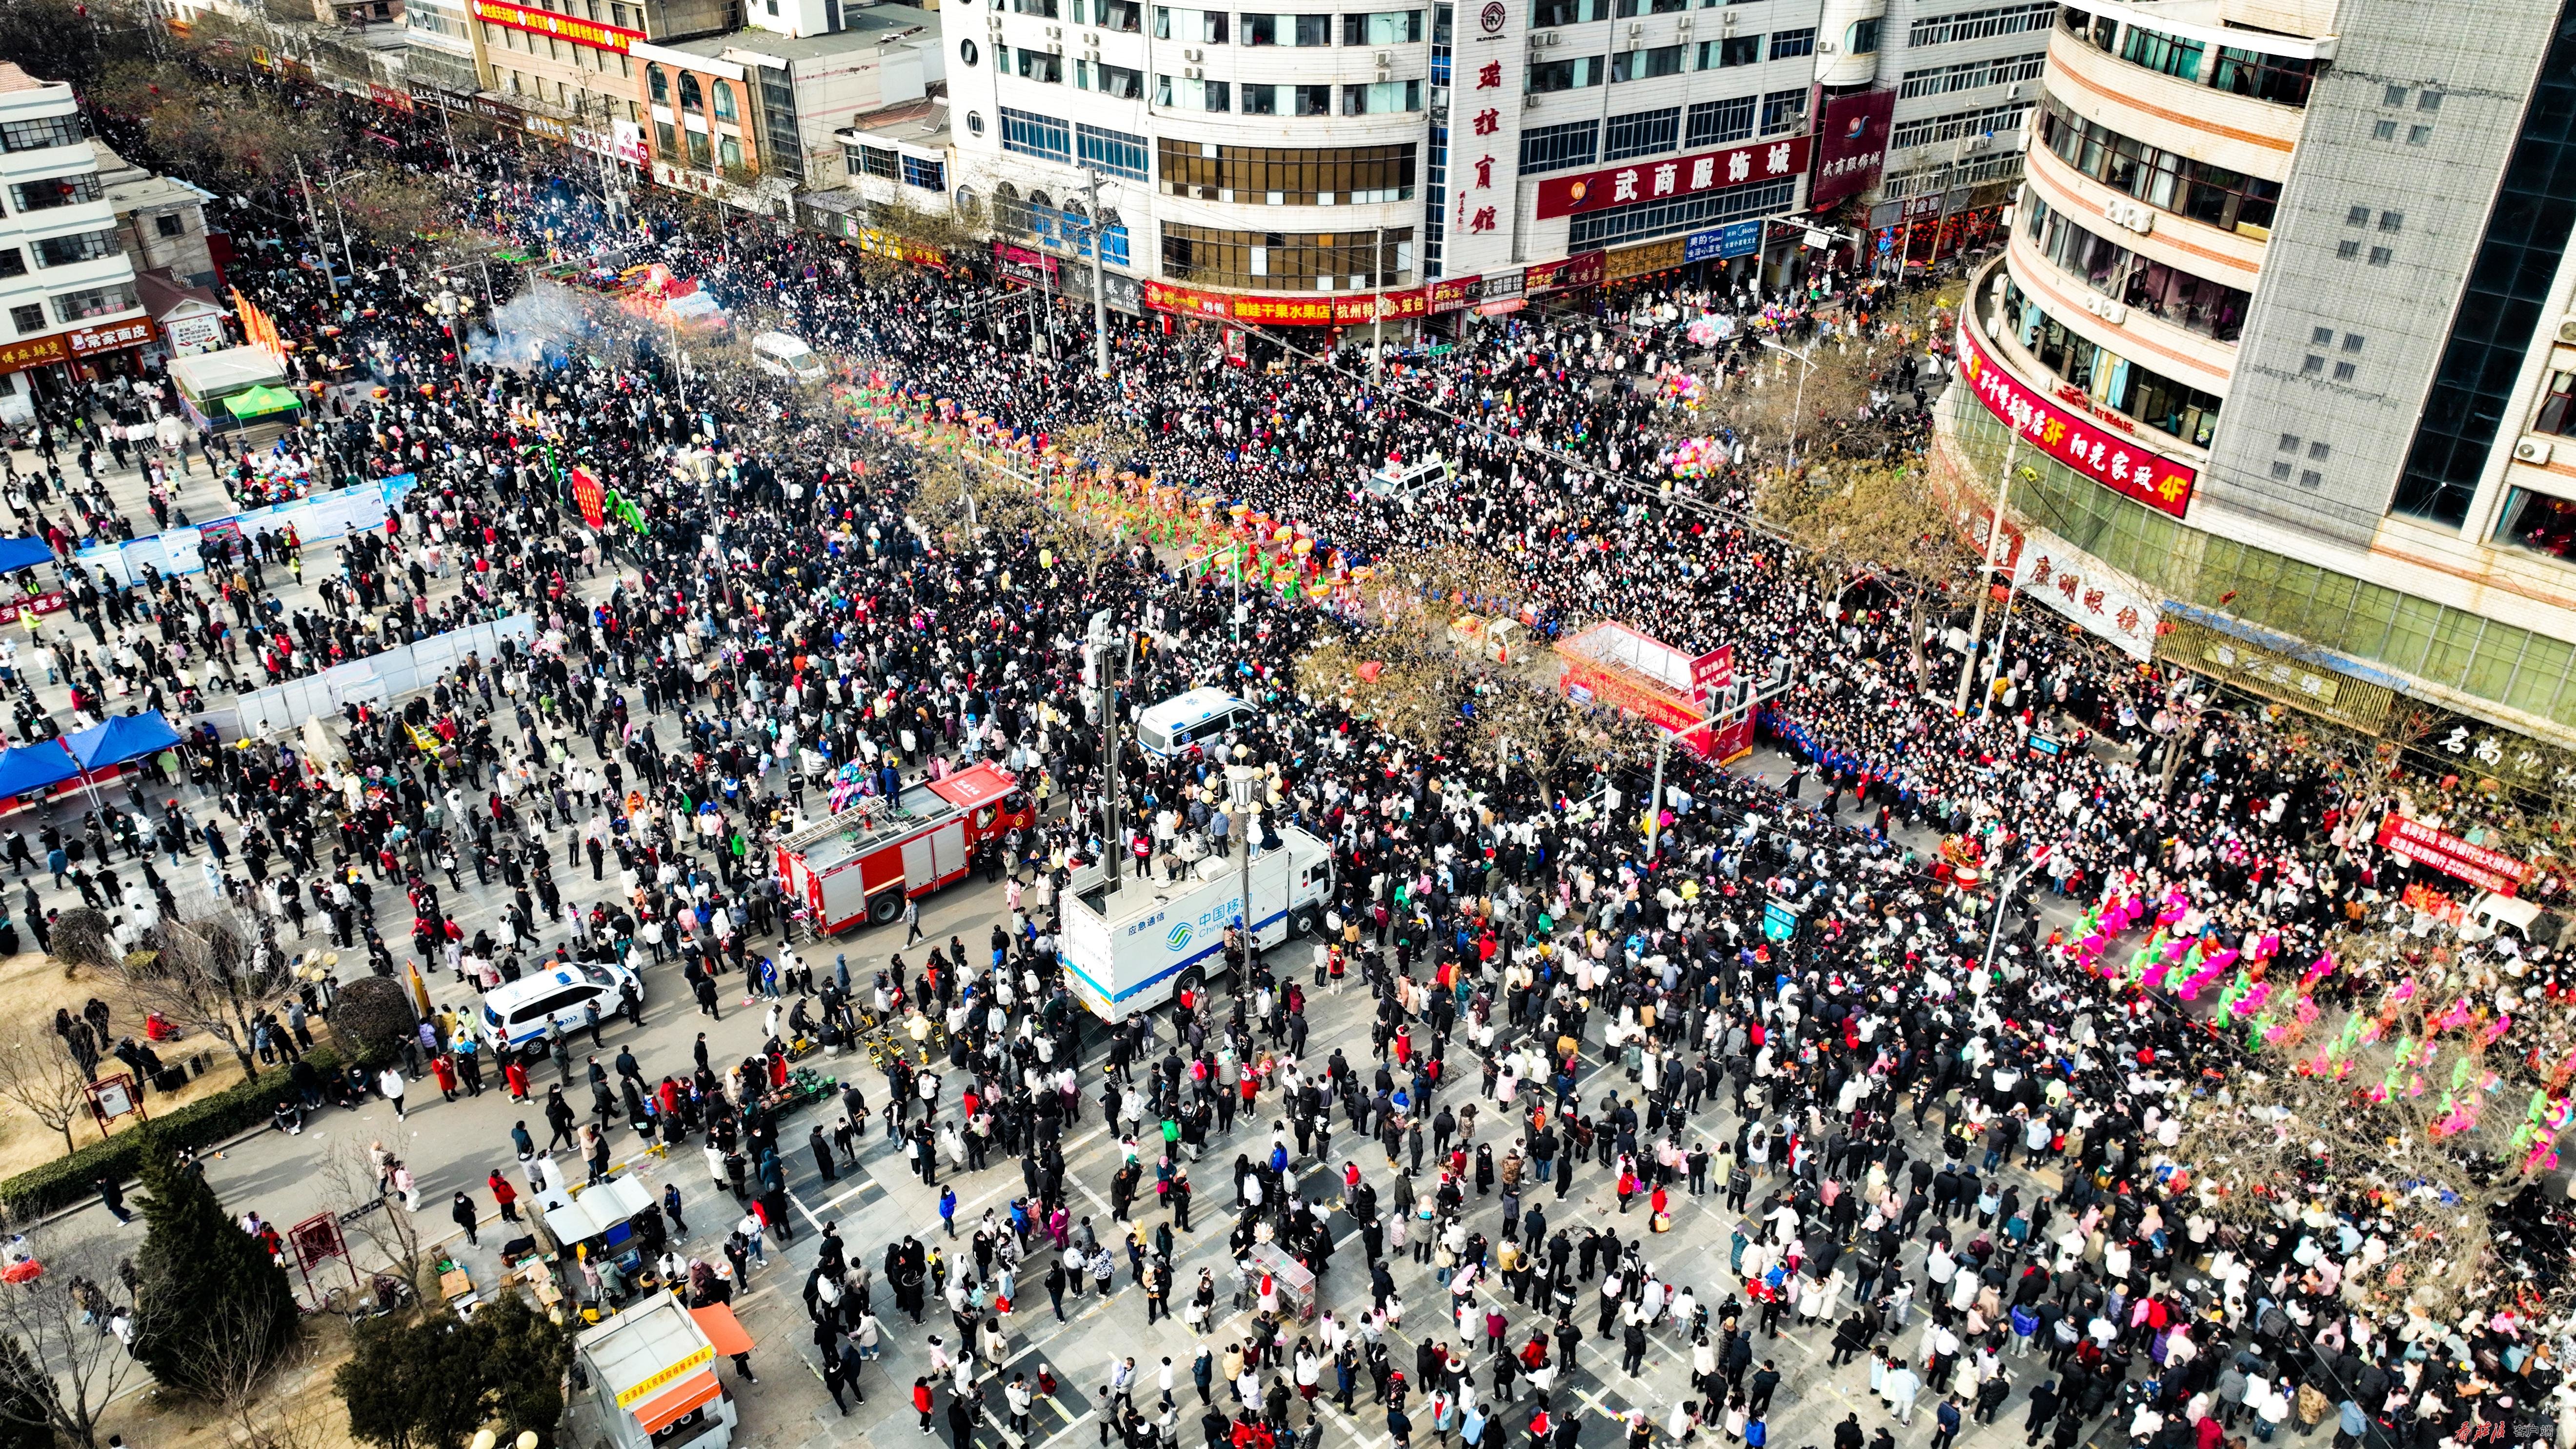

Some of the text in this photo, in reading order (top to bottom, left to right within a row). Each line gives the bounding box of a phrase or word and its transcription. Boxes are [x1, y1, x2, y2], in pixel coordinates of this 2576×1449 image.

[1614, 142, 1791, 202] 武商服饰城
[1823, 151, 1881, 177] 武商服饰城
[1483, 275, 1523, 297] 大明眼镜
[1235, 302, 1331, 319] 狼娃干果水果店
[1337, 297, 1424, 319] 杭州特小笼包
[2043, 417, 2067, 447] 3F
[2158, 475, 2188, 503] 4F
[957, 780, 981, 795] 5414
[1128, 912, 1165, 936] 应急通信
[1199, 922, 1224, 938] China
[624, 1351, 707, 1403] 庄浪县人民医院核酸采集点
